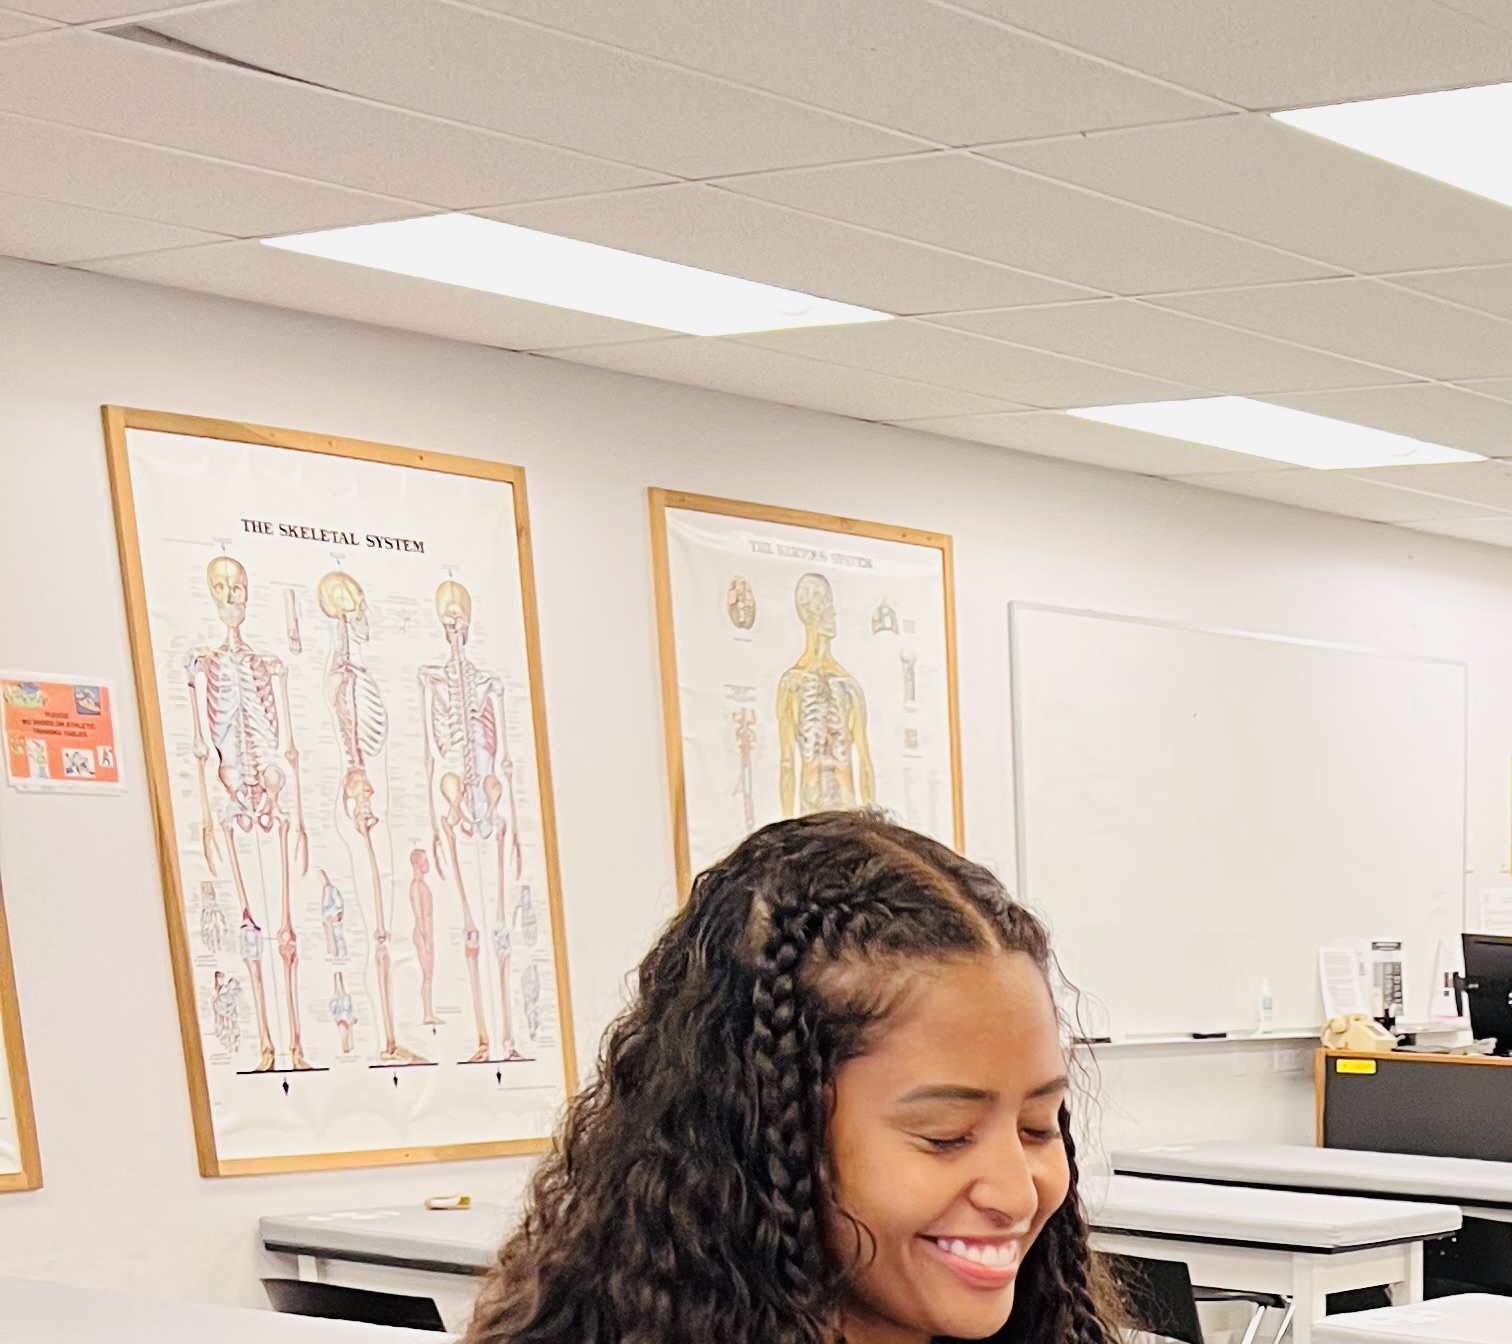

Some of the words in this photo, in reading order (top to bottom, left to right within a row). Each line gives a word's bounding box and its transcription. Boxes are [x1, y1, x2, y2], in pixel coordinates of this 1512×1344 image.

[240, 518, 273, 534] THE
[279, 523, 360, 546] SKELETAL
[366, 534, 425, 553] SYSTEM
